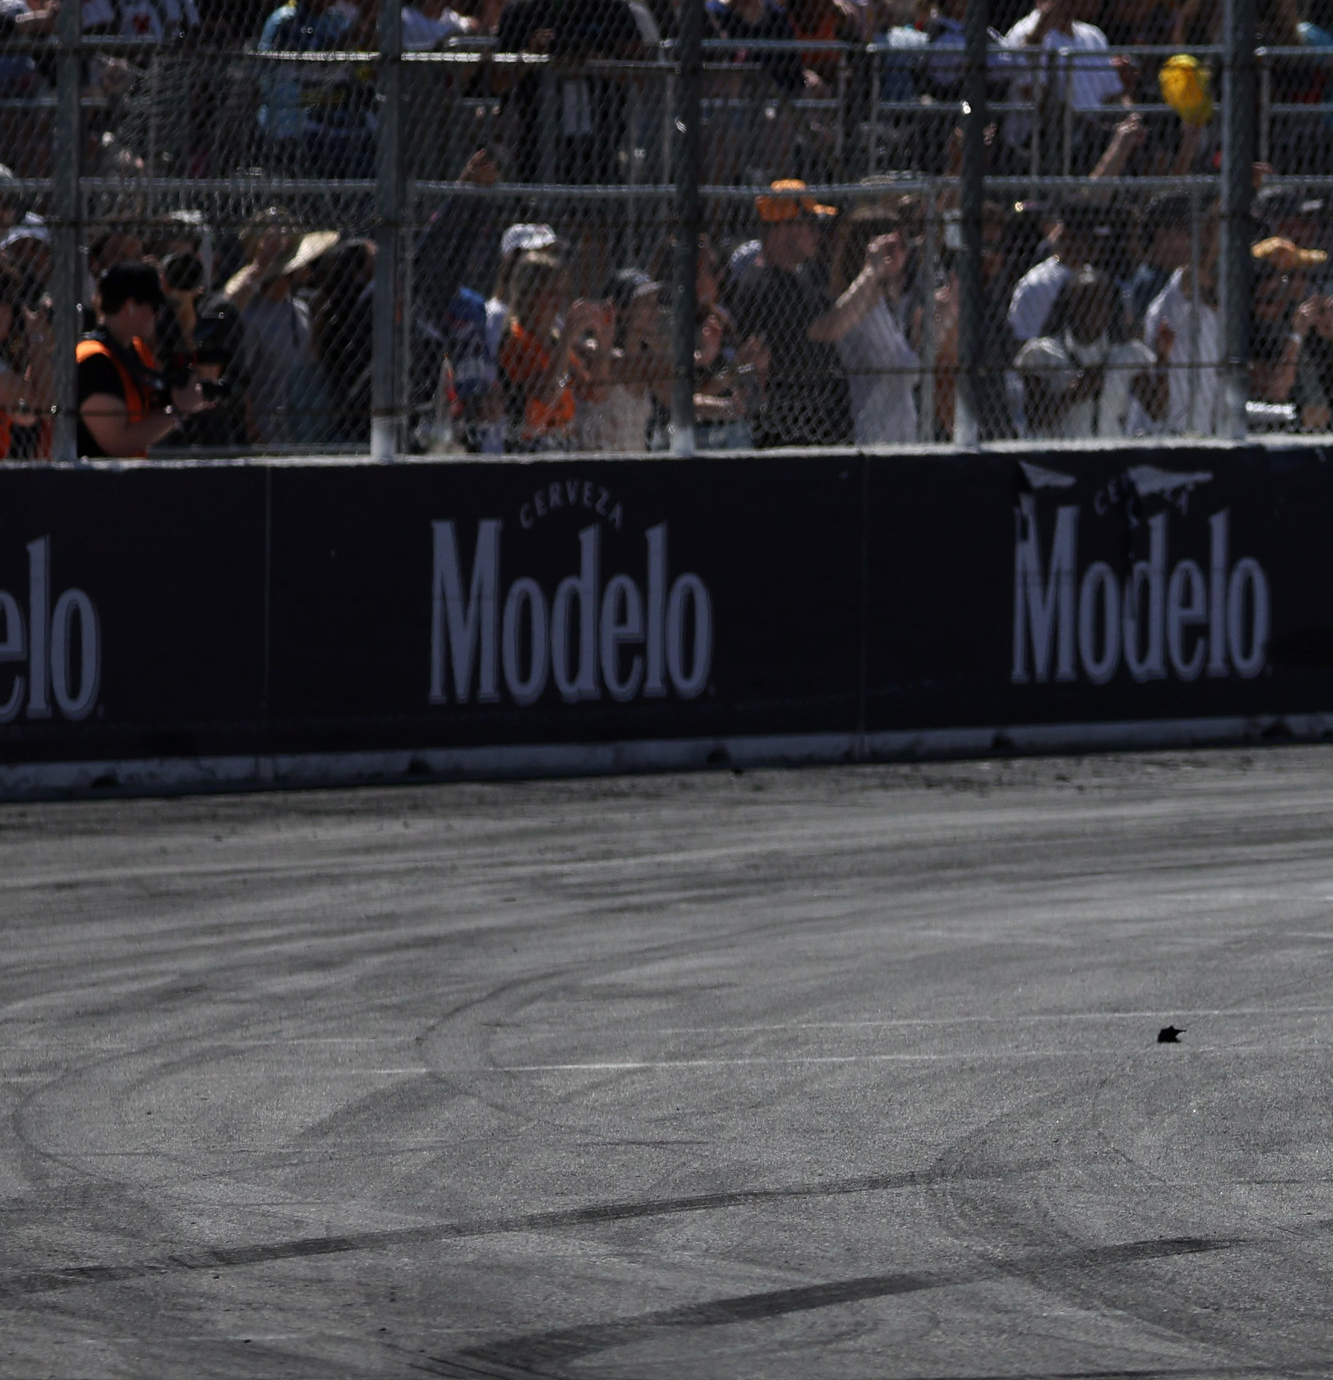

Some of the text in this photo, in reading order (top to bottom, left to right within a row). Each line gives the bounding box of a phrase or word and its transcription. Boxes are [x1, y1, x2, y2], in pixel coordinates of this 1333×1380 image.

[519, 479, 624, 531] CERVEZA
[1011, 492, 1270, 683] Modelo
[427, 518, 715, 707] Modelo
